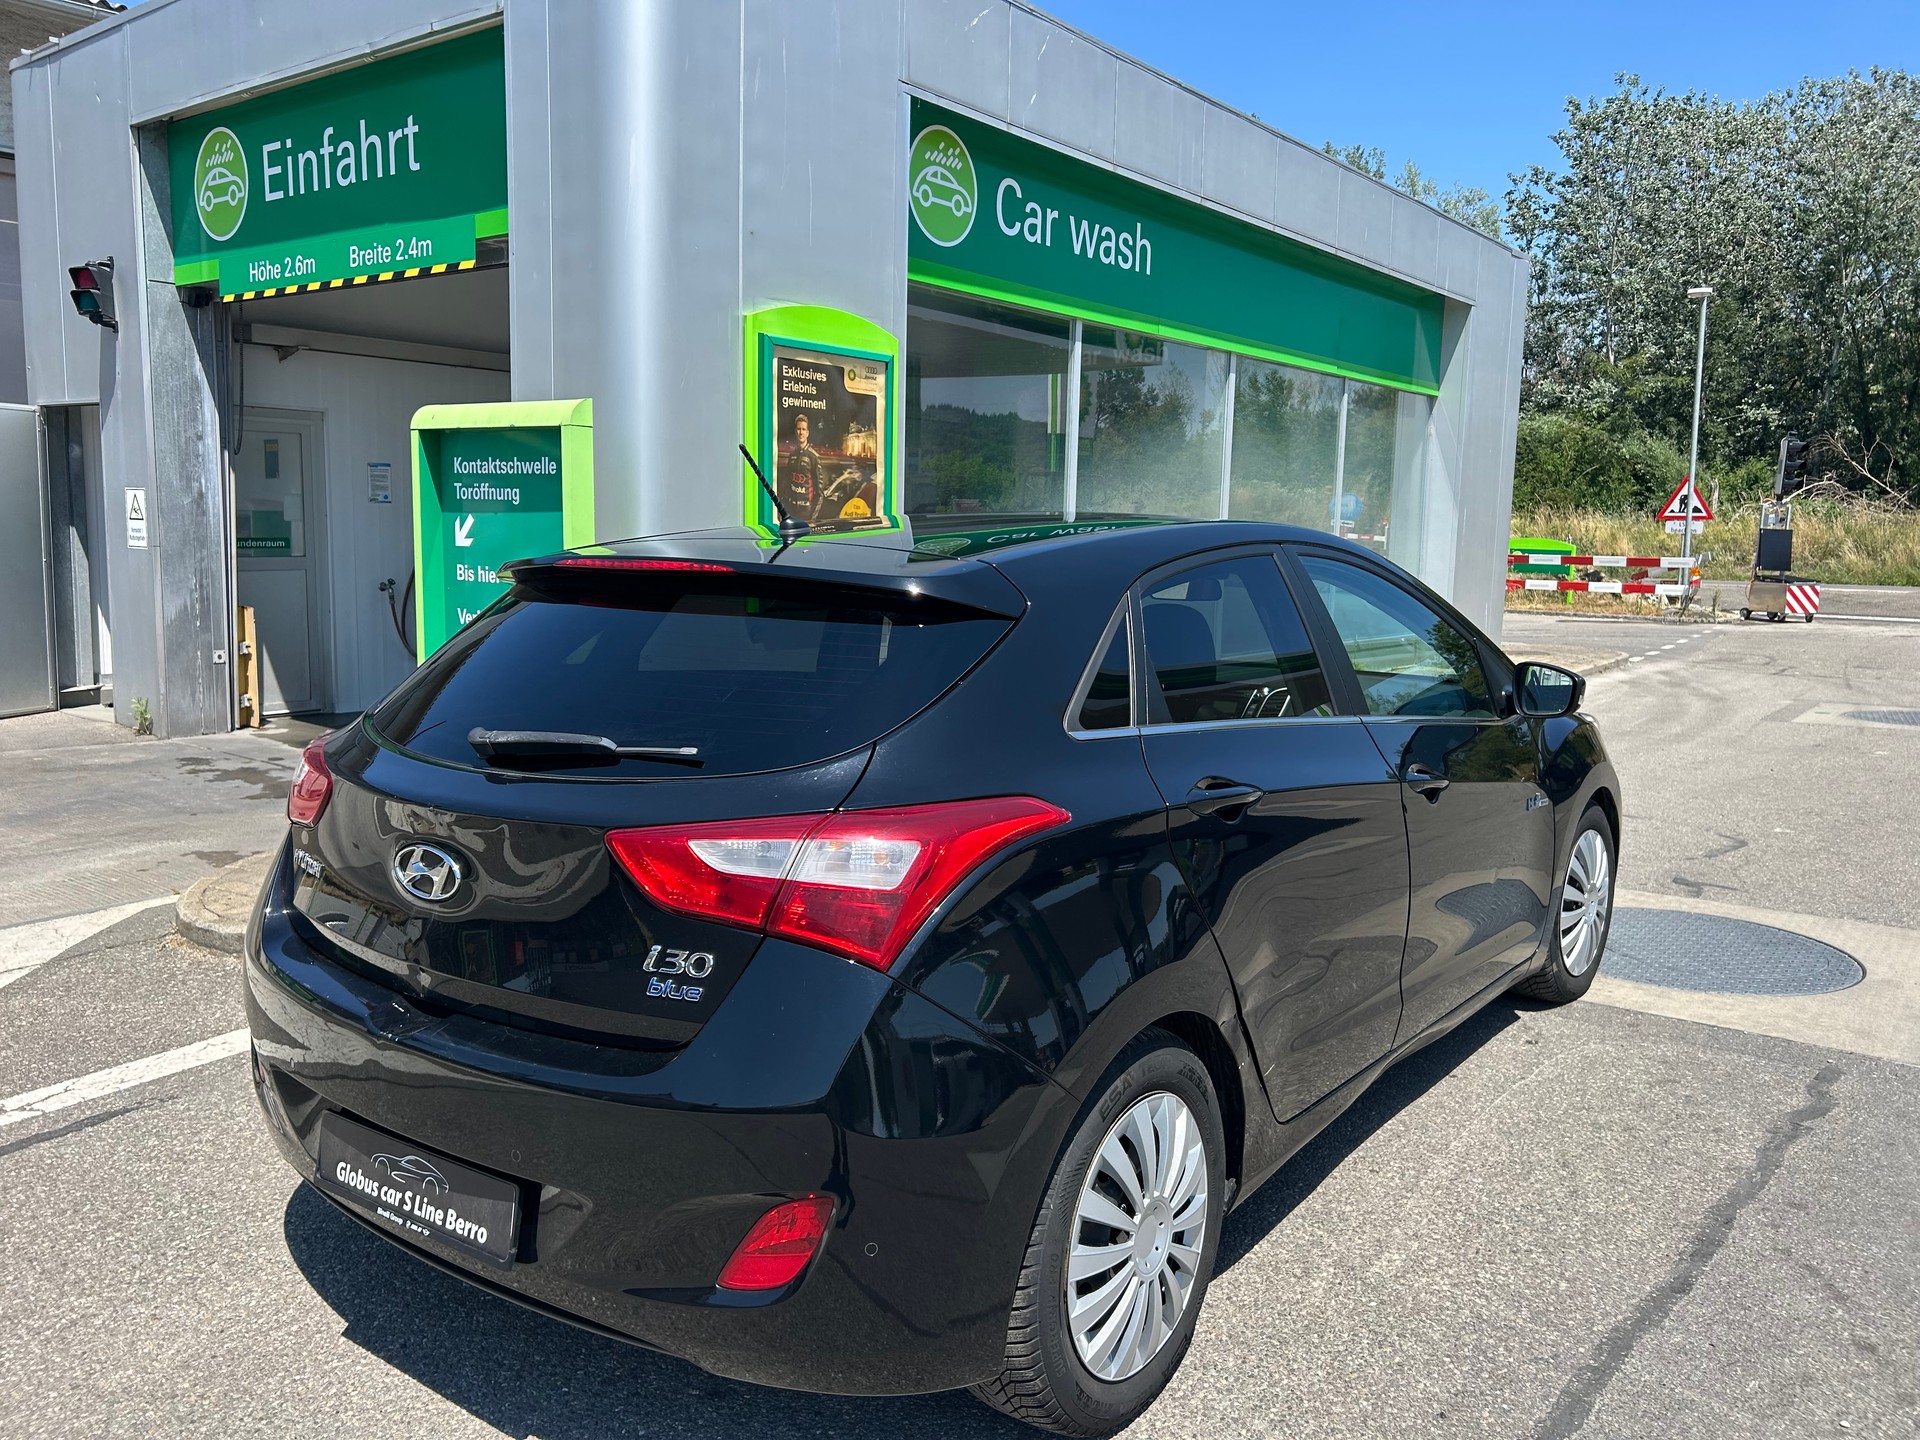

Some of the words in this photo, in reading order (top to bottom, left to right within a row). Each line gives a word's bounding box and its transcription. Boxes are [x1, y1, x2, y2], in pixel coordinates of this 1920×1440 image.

[262, 114, 420, 202] Einfahrt
[996, 177, 1059, 247] Car
[1069, 215, 1152, 276] wash
[349, 242, 392, 268] Breite
[395, 236, 432, 261] 2.4m
[249, 260, 281, 282] Höhe
[284, 255, 316, 277] 2.6m
[782, 364, 827, 382] Exklusives
[782, 379, 817, 395] Erlebnis
[782, 396, 827, 410] gewinnen!
[453, 456, 557, 475] Kontaktschwelle
[453, 482, 520, 505] Toröffnung
[236, 539, 285, 548] undenraum
[456, 563, 475, 582] Bis
[643, 944, 714, 978] i30
[646, 977, 703, 1001] blue
[336, 1161, 379, 1197] Globus
[380, 1183, 402, 1208] car
[402, 1190, 413, 1212] S
[413, 1193, 444, 1226] Line
[445, 1208, 488, 1244] Berro
